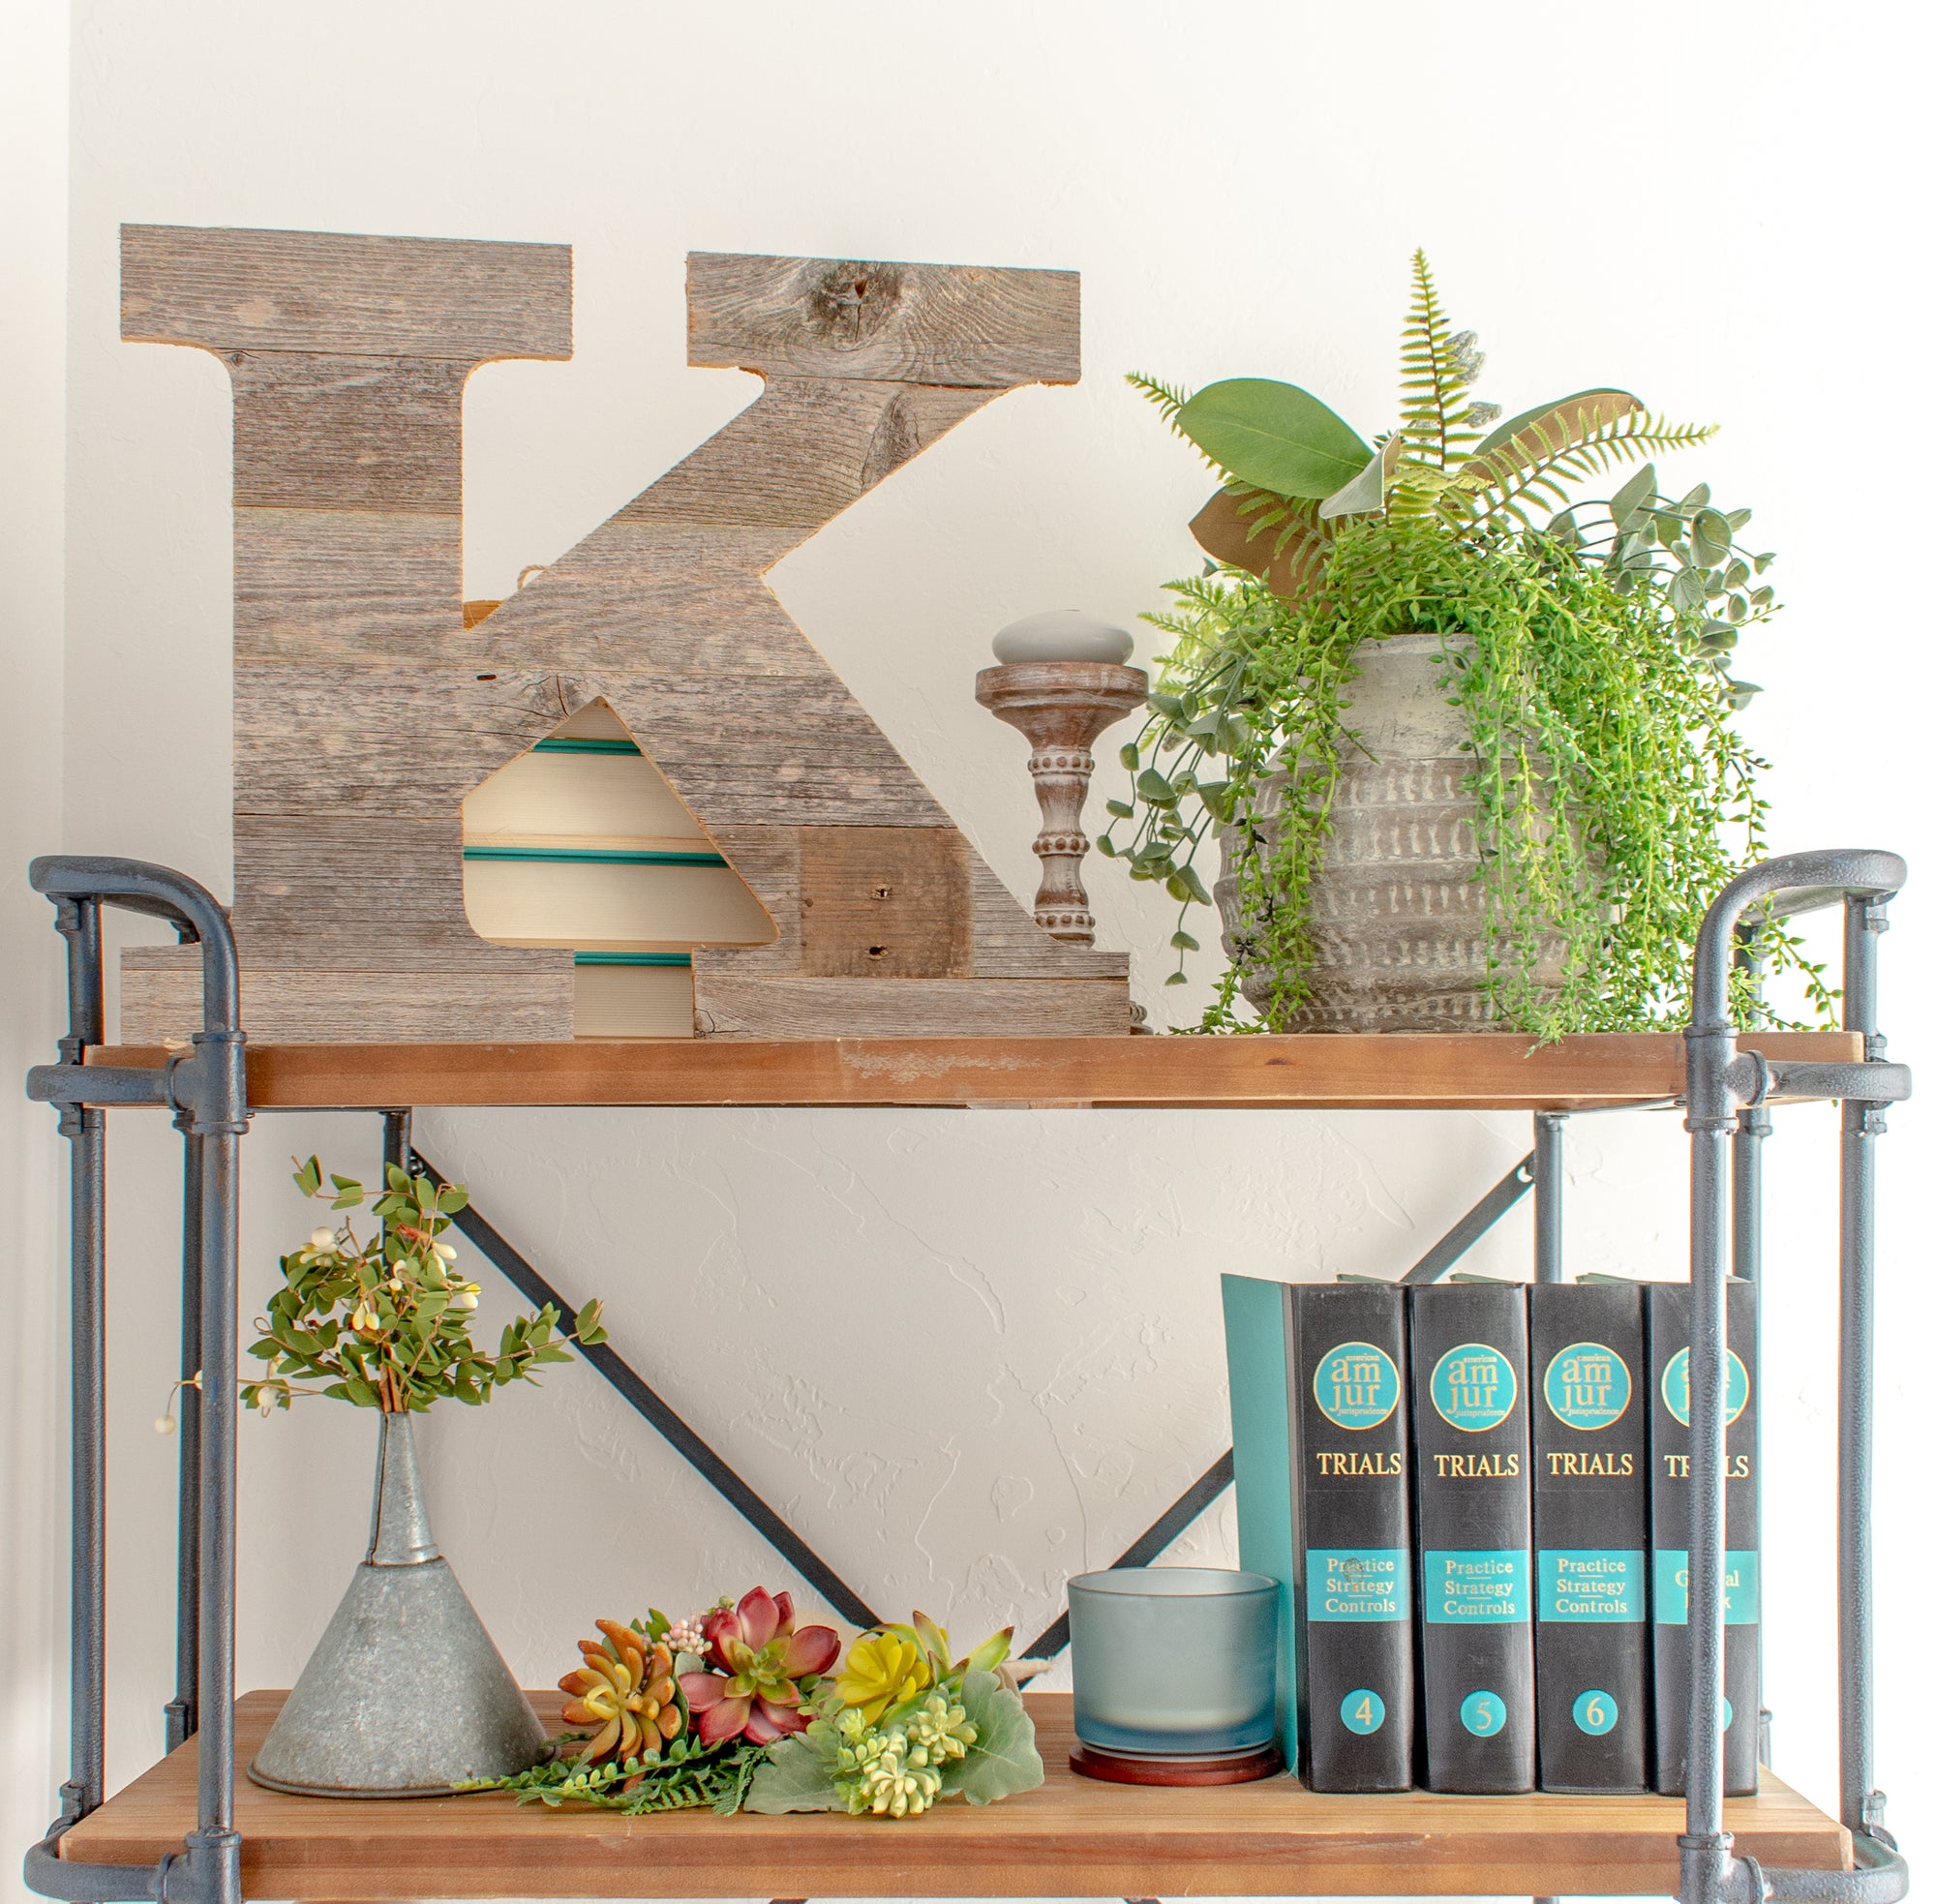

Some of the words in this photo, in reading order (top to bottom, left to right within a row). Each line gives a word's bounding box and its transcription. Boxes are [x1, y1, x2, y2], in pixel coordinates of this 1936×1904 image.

[120, 223, 1131, 1041] K
[1331, 1358, 1381, 1382] am
[1448, 1360, 1498, 1384] am
[1561, 1358, 1612, 1382] am
[1329, 1384, 1381, 1411] jur
[1446, 1385, 1497, 1413] jur
[1559, 1384, 1611, 1411] jur
[1316, 1453, 1402, 1475] TRIALS
[1434, 1454, 1519, 1477] TRIALS
[1547, 1453, 1633, 1475] TRIALS
[1664, 1455, 1750, 1477] TRLS
[1445, 1559, 1514, 1574] Practice
[1557, 1558, 1626, 1573] Practice
[1326, 1579, 1394, 1594] Strategy
[1445, 1581, 1513, 1596] Strategy
[1557, 1579, 1625, 1595] Strategy
[1325, 1599, 1396, 1613] Controls
[1443, 1600, 1515, 1615] Controls
[1556, 1599, 1627, 1613] Controls
[1355, 1697, 1373, 1725] 4
[1476, 1701, 1492, 1730] 5
[1587, 1697, 1604, 1726] 6
